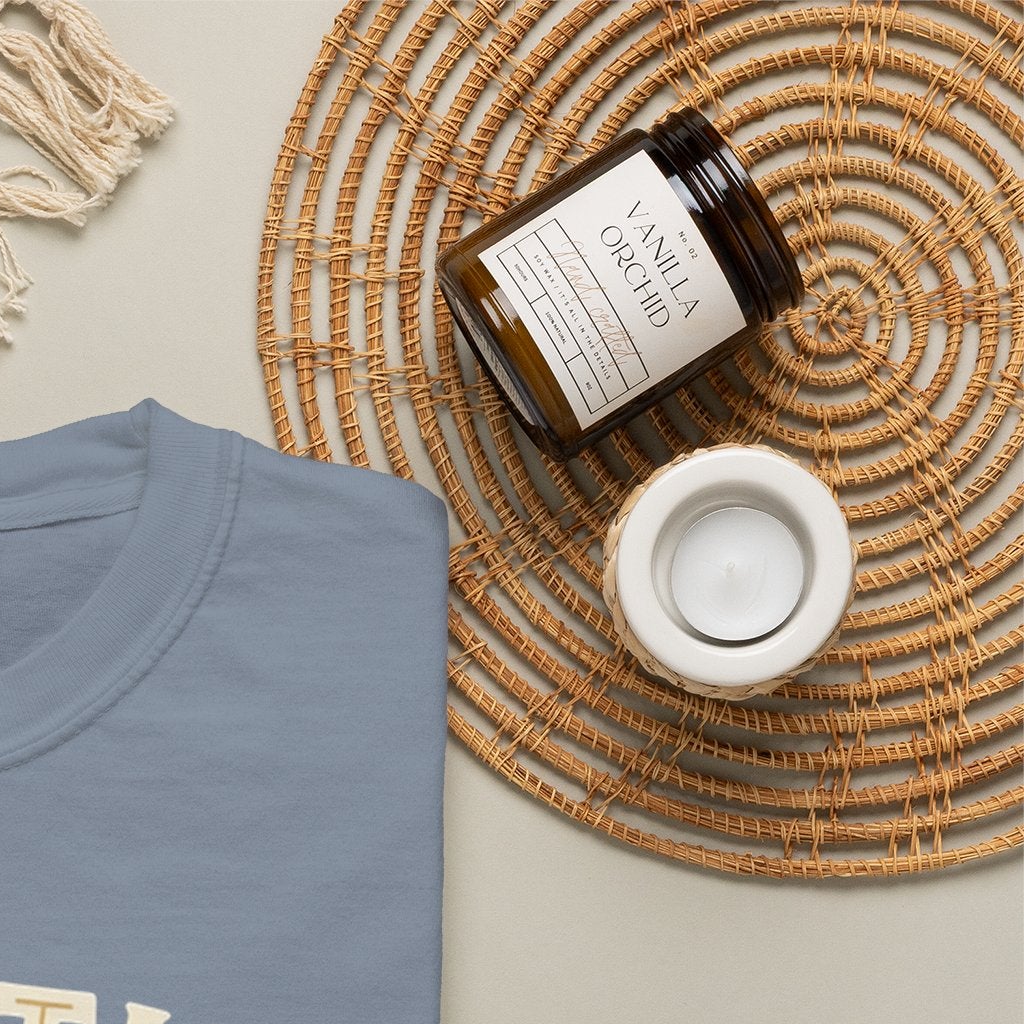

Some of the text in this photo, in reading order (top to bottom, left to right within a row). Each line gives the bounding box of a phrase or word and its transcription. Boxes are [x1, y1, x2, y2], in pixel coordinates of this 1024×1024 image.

[601, 225, 670, 327] ORCHID
[627, 200, 700, 318] VANILLA
[678, 231, 698, 260] No. 02
[534, 254, 544, 267] SOY
[544, 269, 555, 283] WAX
[558, 291, 569, 306] IT'S
[569, 309, 578, 322] ALL
[579, 324, 586, 334] IN
[585, 335, 595, 350] THE
[593, 352, 611, 380] DETAILS
[553, 323, 567, 345] NATURAL
